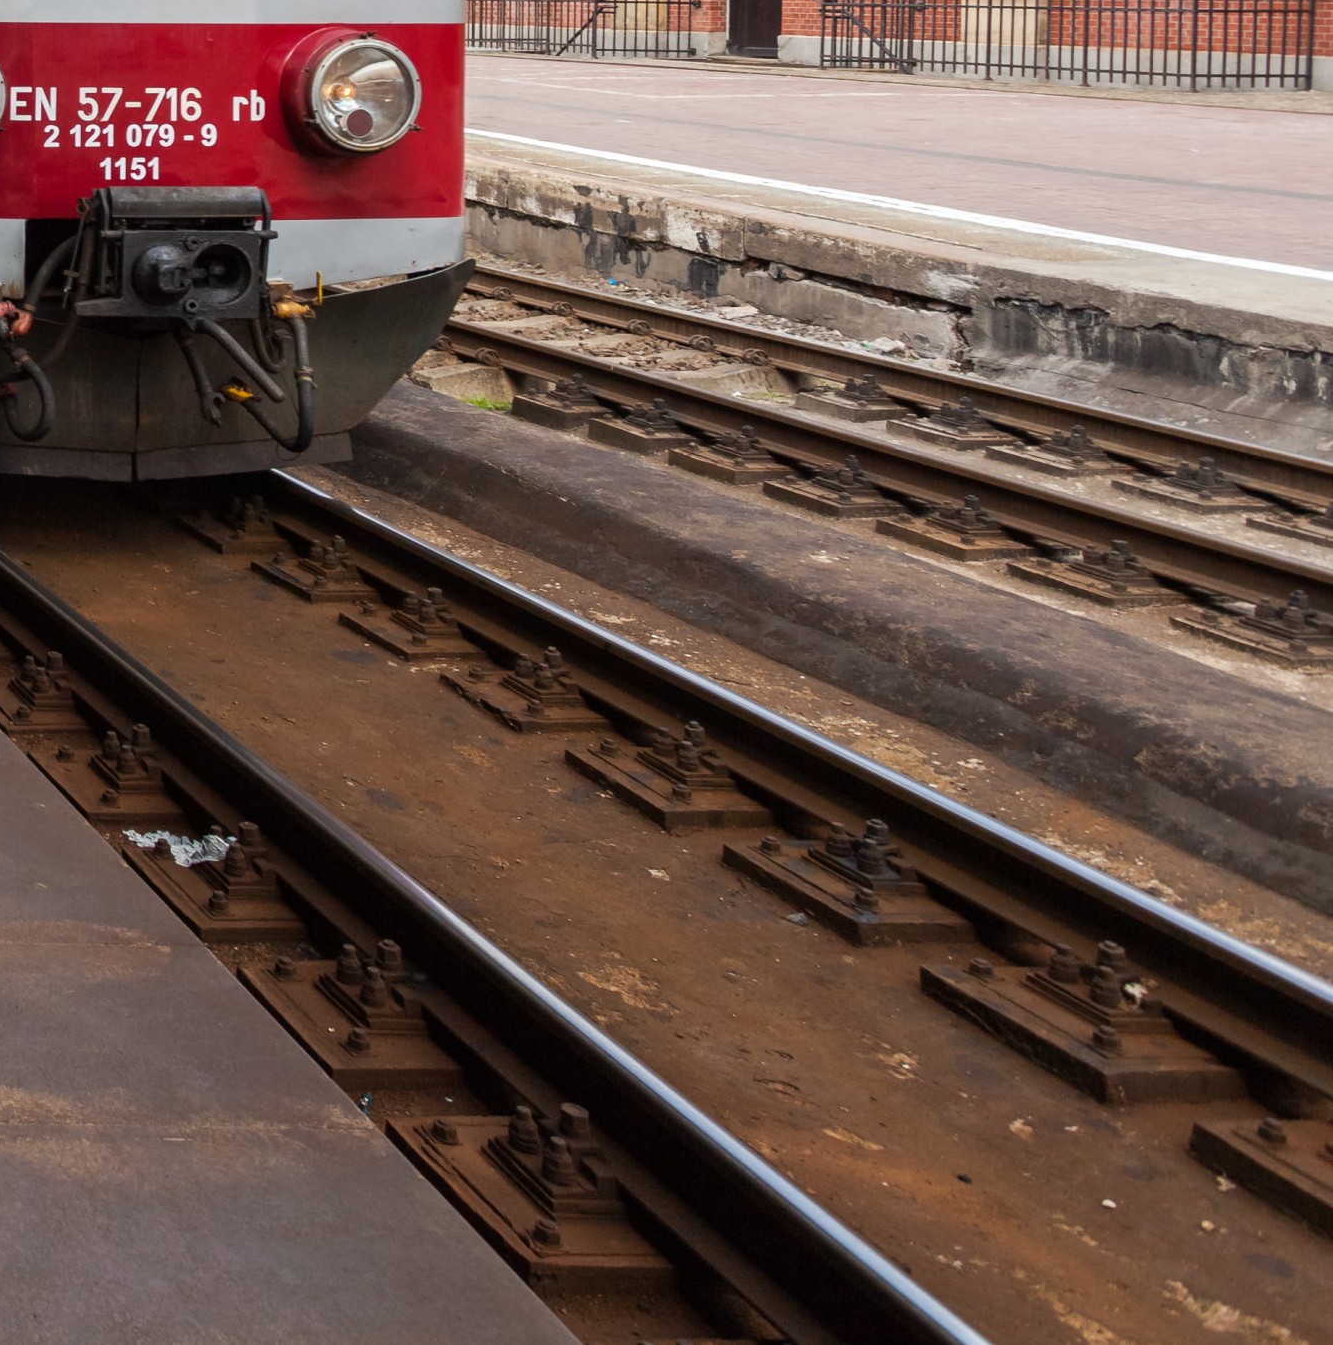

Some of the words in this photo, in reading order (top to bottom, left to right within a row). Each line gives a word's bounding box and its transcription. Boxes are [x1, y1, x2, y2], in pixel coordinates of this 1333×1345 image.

[10, 87, 57, 122] EN
[77, 87, 202, 122] 57-716
[233, 90, 266, 122] rb
[44, 125, 60, 147] 2
[70, 124, 115, 148] 121
[126, 123, 175, 148] 079
[201, 123, 218, 147] 9
[100, 157, 160, 181] 1151
